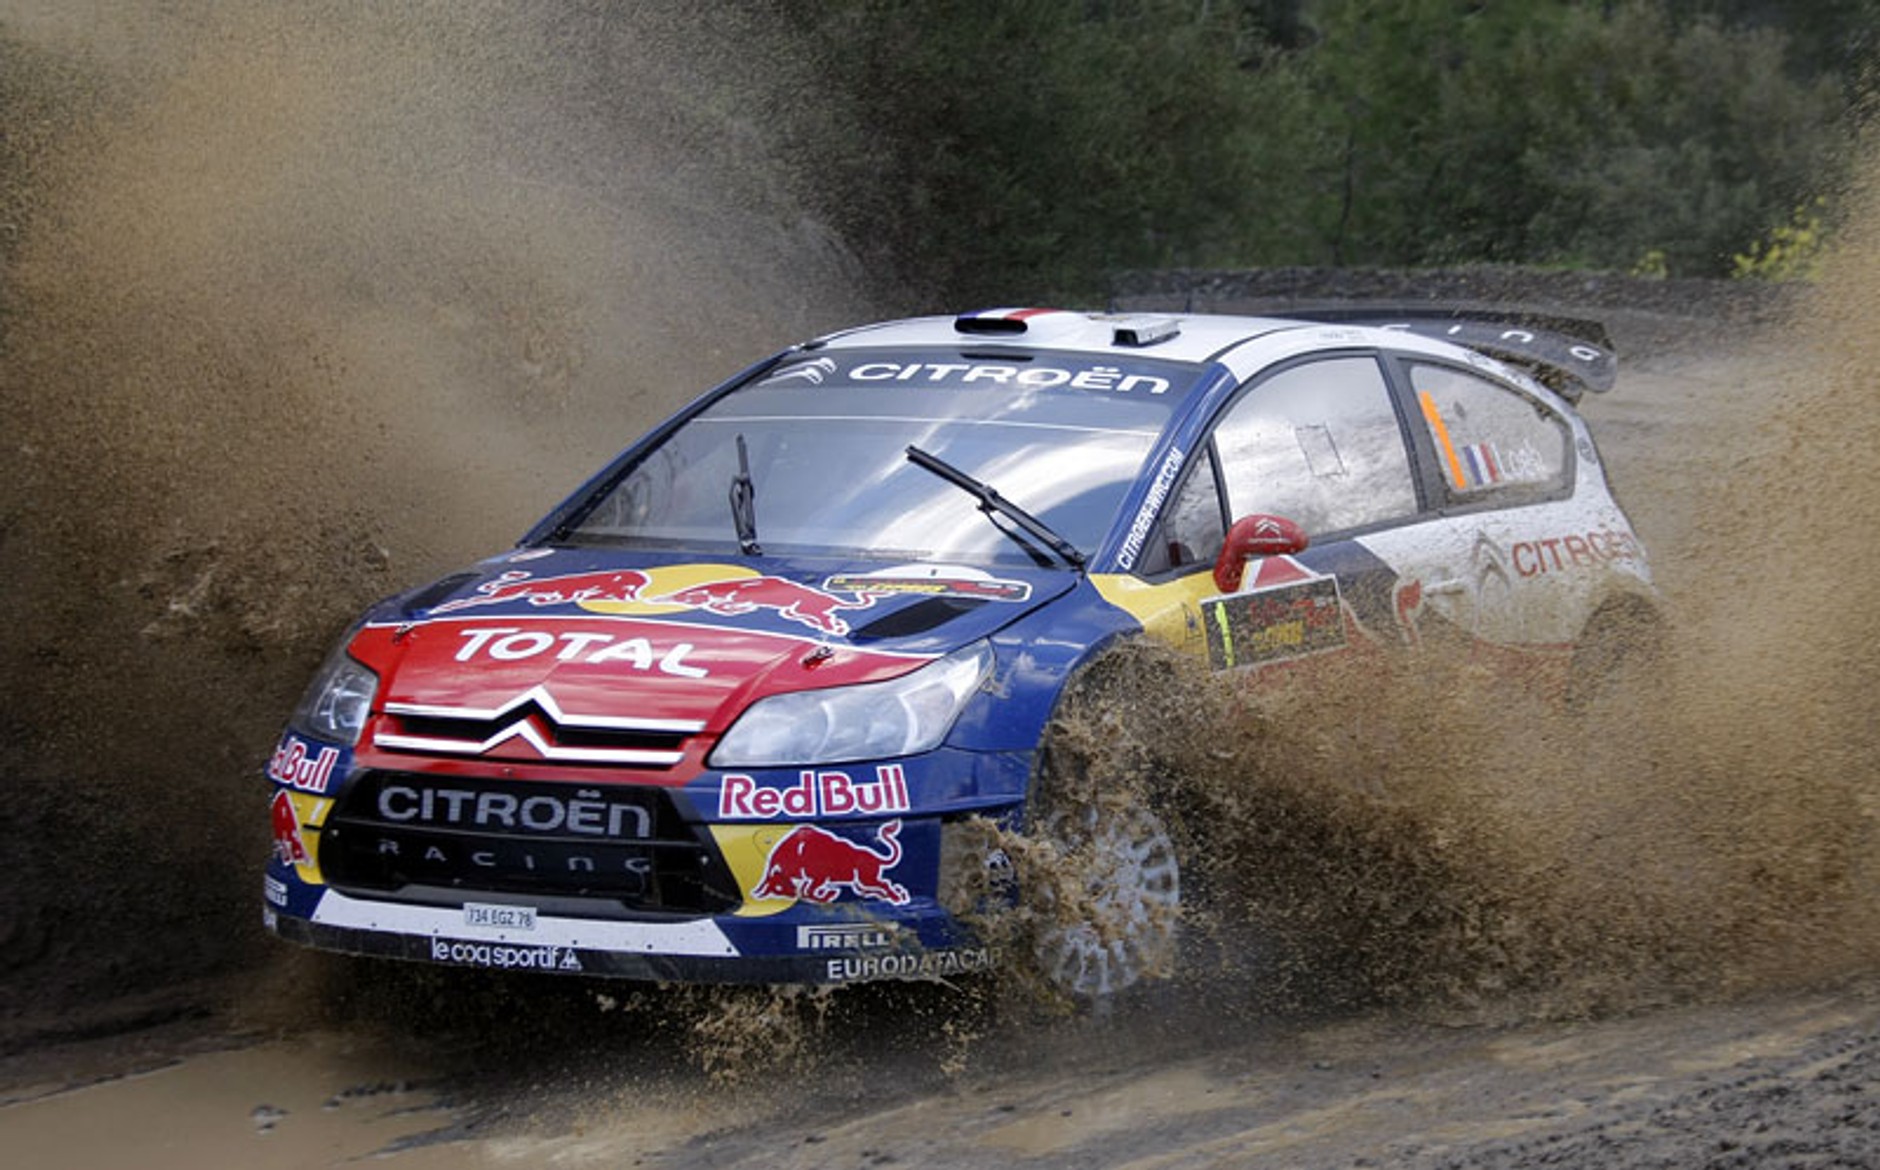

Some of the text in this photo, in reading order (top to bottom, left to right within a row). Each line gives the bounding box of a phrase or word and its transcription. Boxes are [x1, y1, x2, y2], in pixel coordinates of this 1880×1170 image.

[849, 362, 1170, 394] CITROËN
[455, 628, 708, 678] TOTAL
[720, 765, 911, 818] Red Bull
[378, 787, 651, 838] CITROËN
[432, 936, 560, 969] le coq sportif
[797, 922, 899, 949] PIRELL
